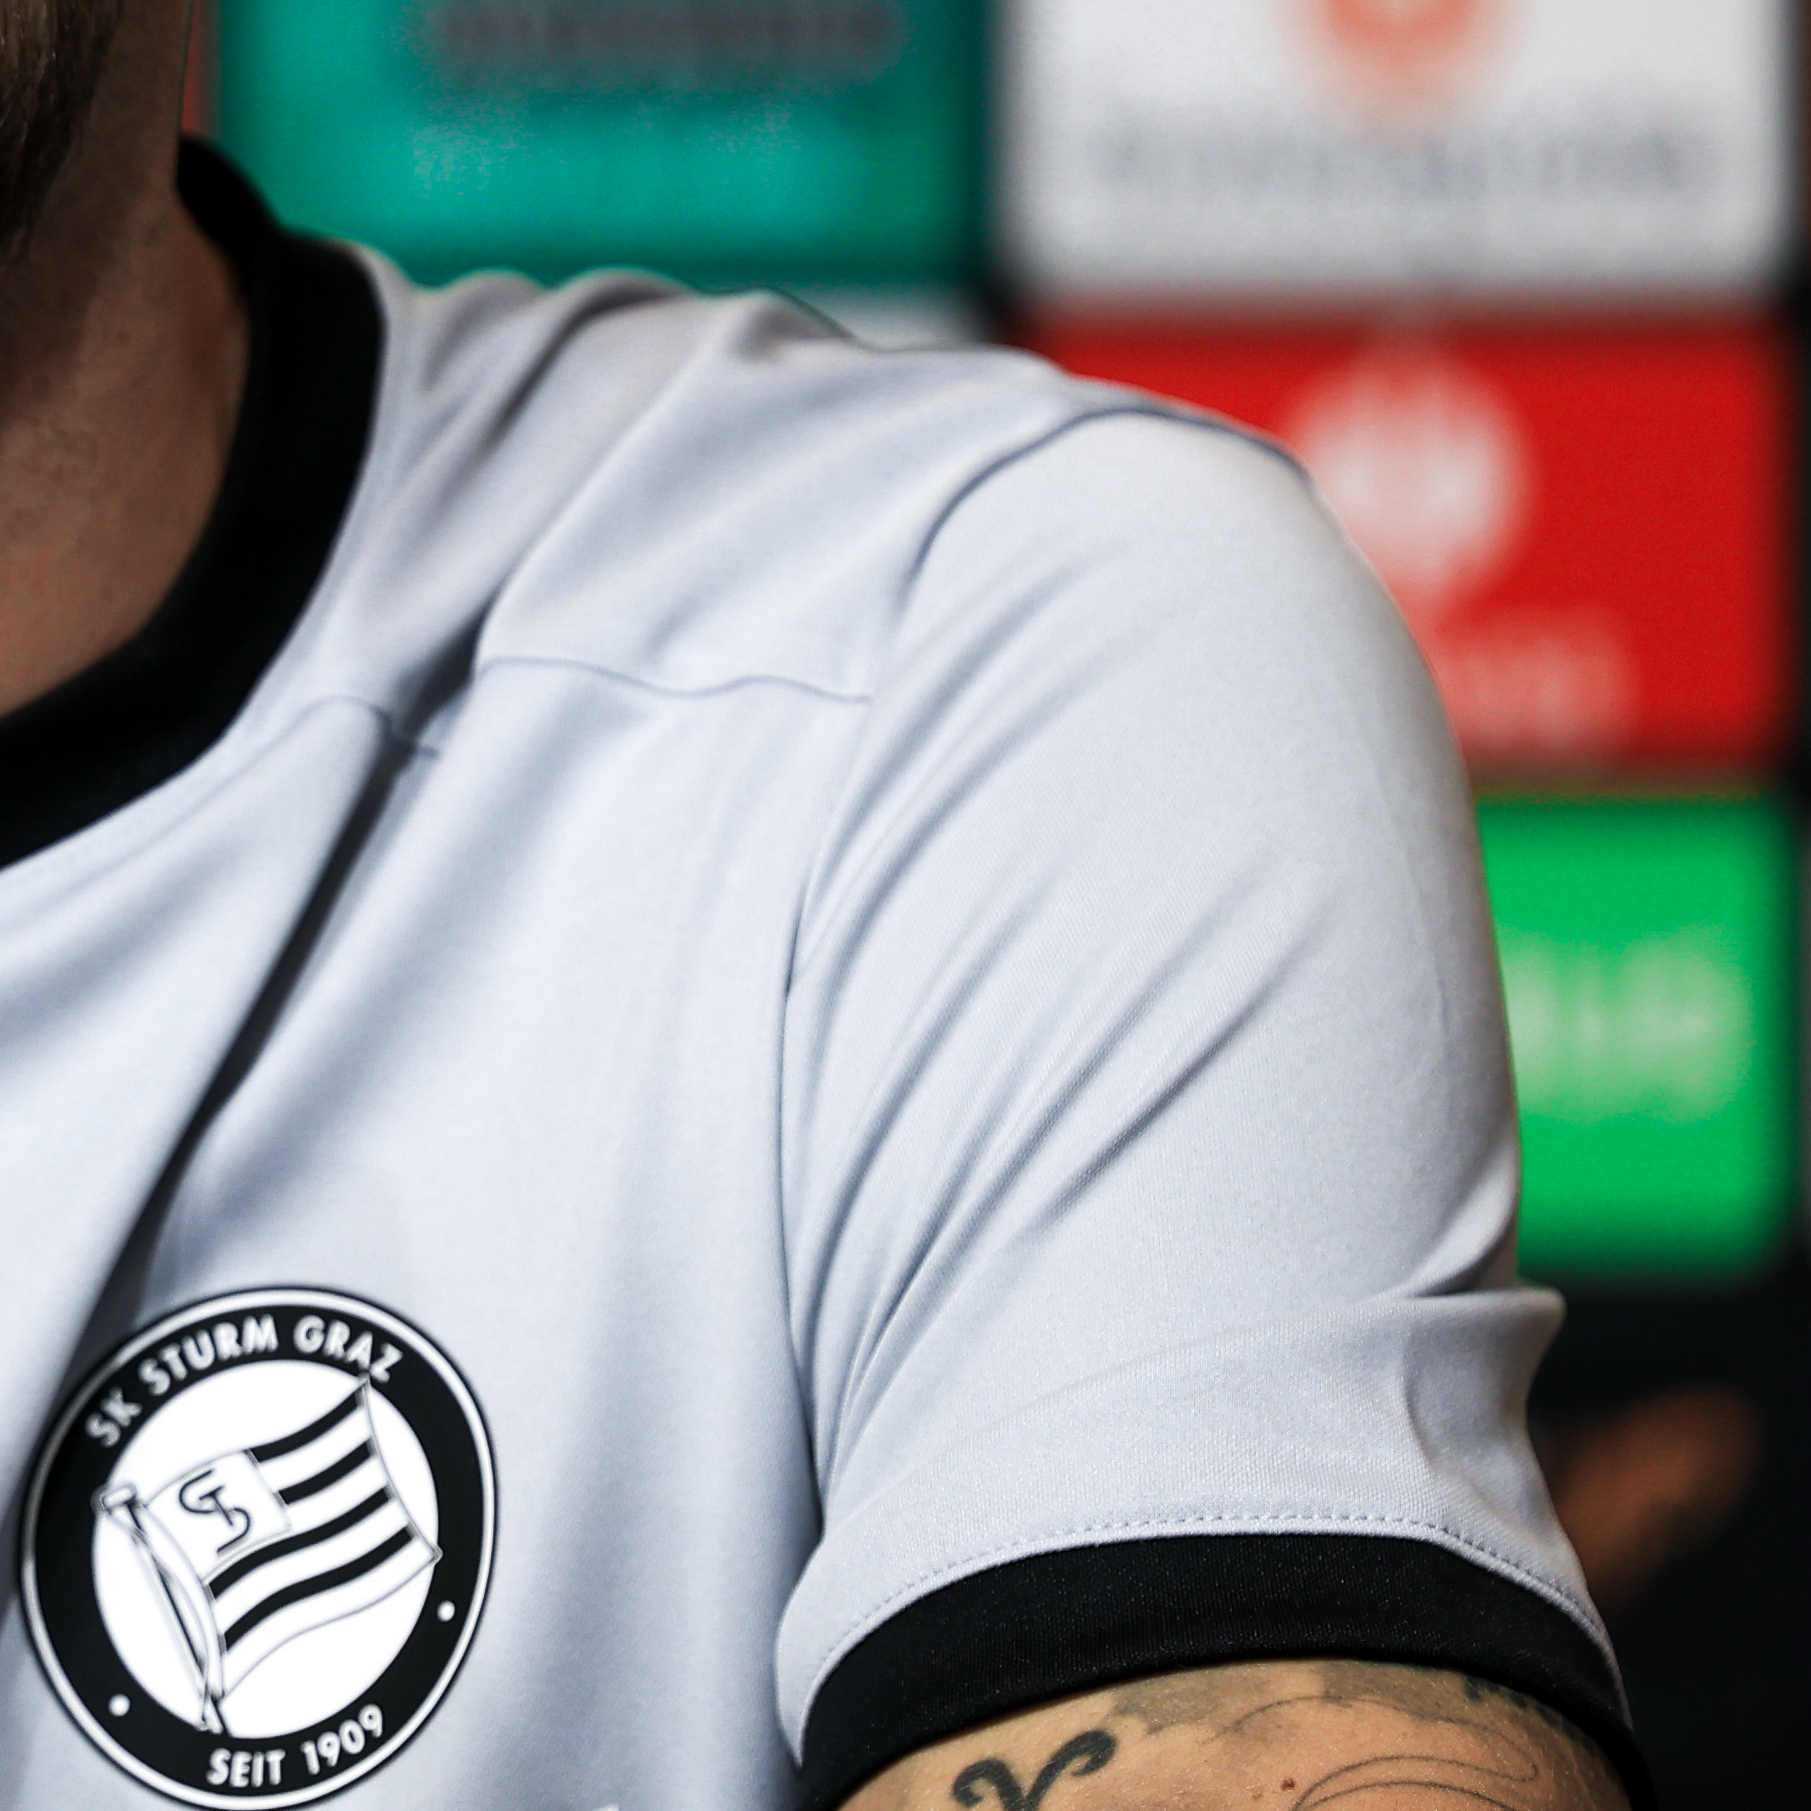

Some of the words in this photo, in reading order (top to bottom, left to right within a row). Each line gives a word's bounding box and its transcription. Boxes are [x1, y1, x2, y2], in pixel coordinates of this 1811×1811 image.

[85, 1387, 143, 1447] SK
[137, 1313, 279, 1396] STURM
[292, 1314, 404, 1383] GRAZ
[205, 1747, 286, 1788] SEIT
[299, 1703, 384, 1775] 1909
